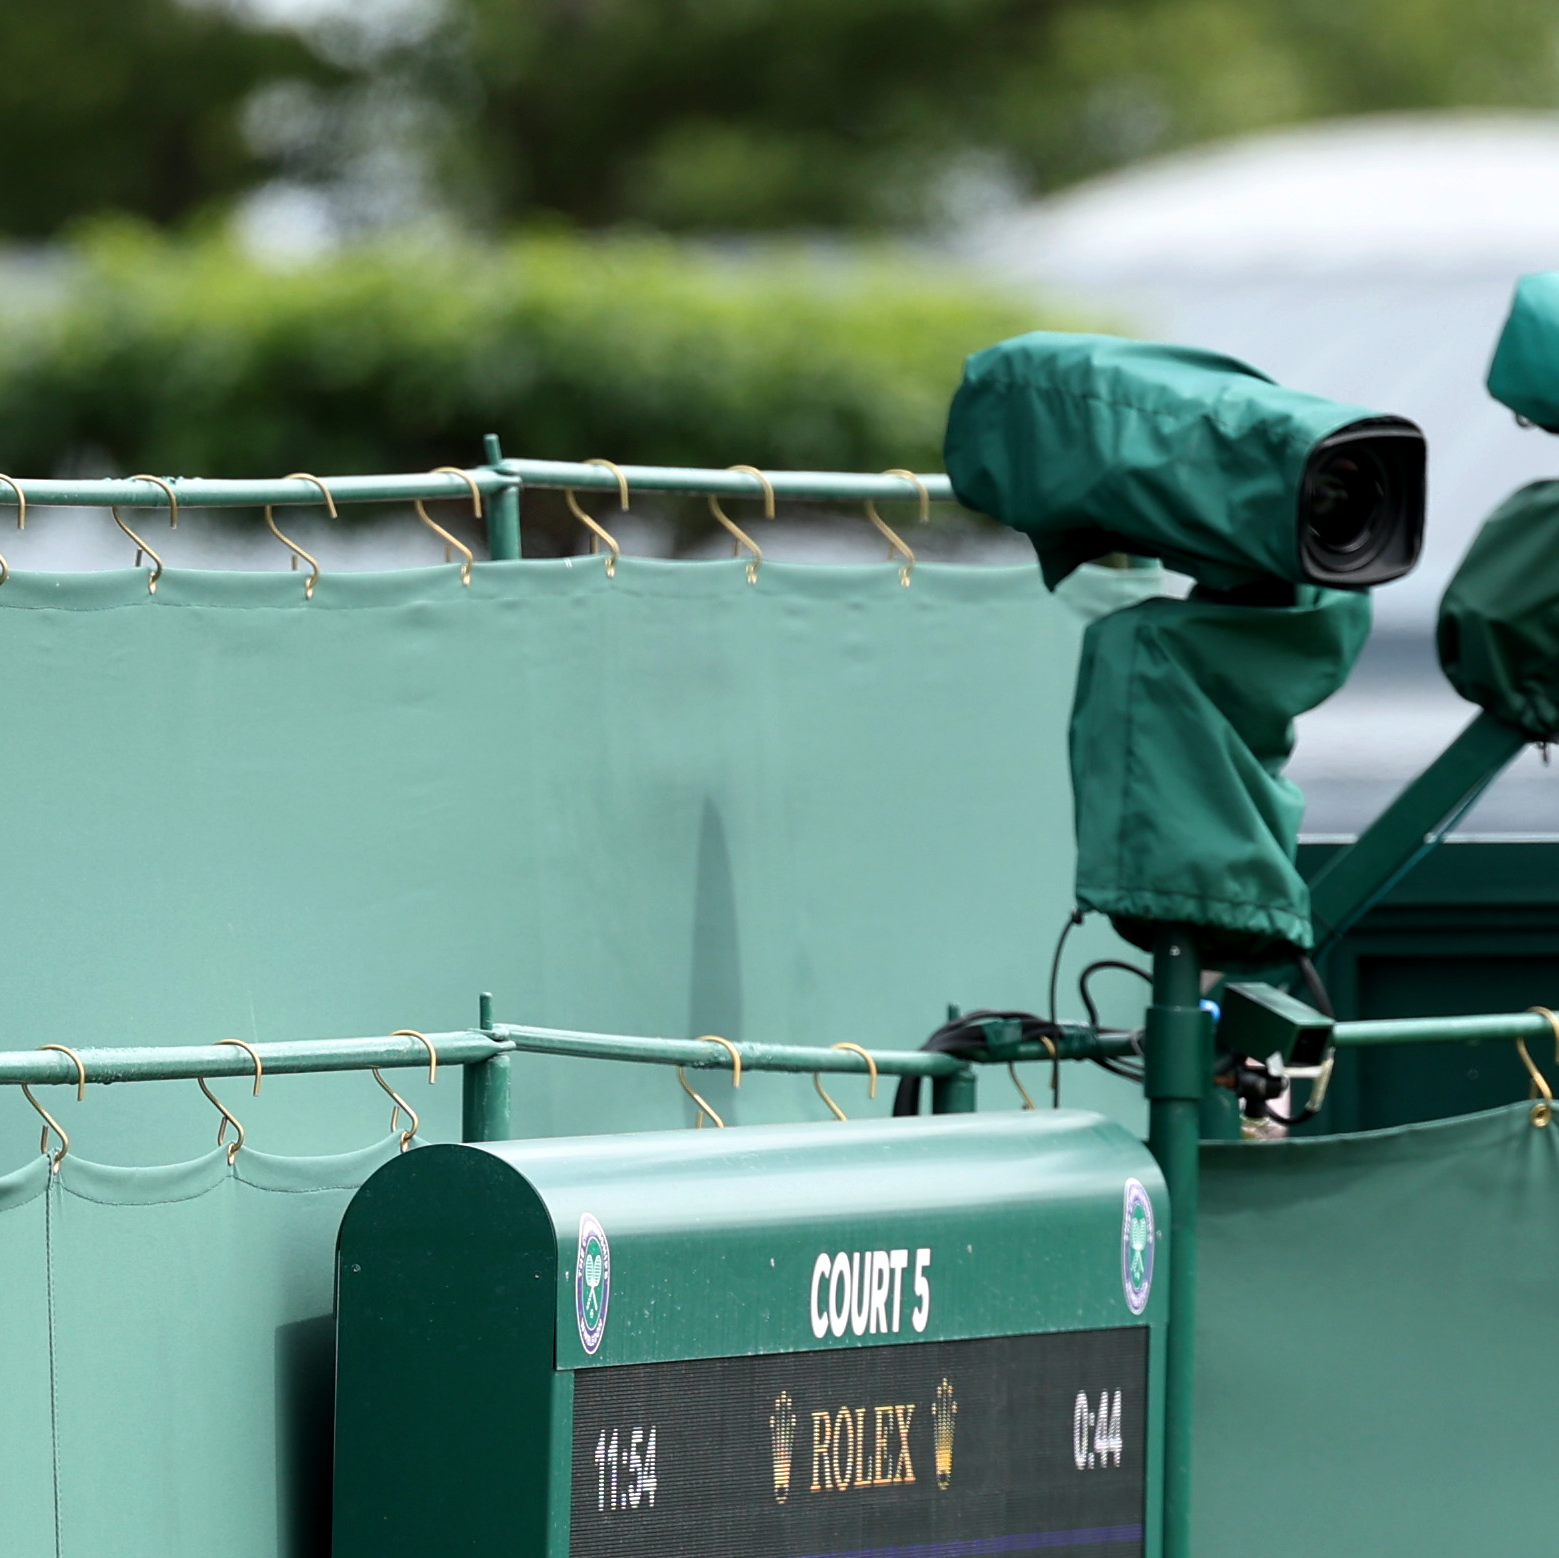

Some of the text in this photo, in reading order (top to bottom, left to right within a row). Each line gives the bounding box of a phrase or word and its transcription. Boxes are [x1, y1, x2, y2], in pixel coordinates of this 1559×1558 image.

[809, 1247, 932, 1338] COURT 5
[594, 1425, 657, 1512] 11:54
[810, 1404, 917, 1492] ROLEX
[1072, 1387, 1123, 1471] 0:44
